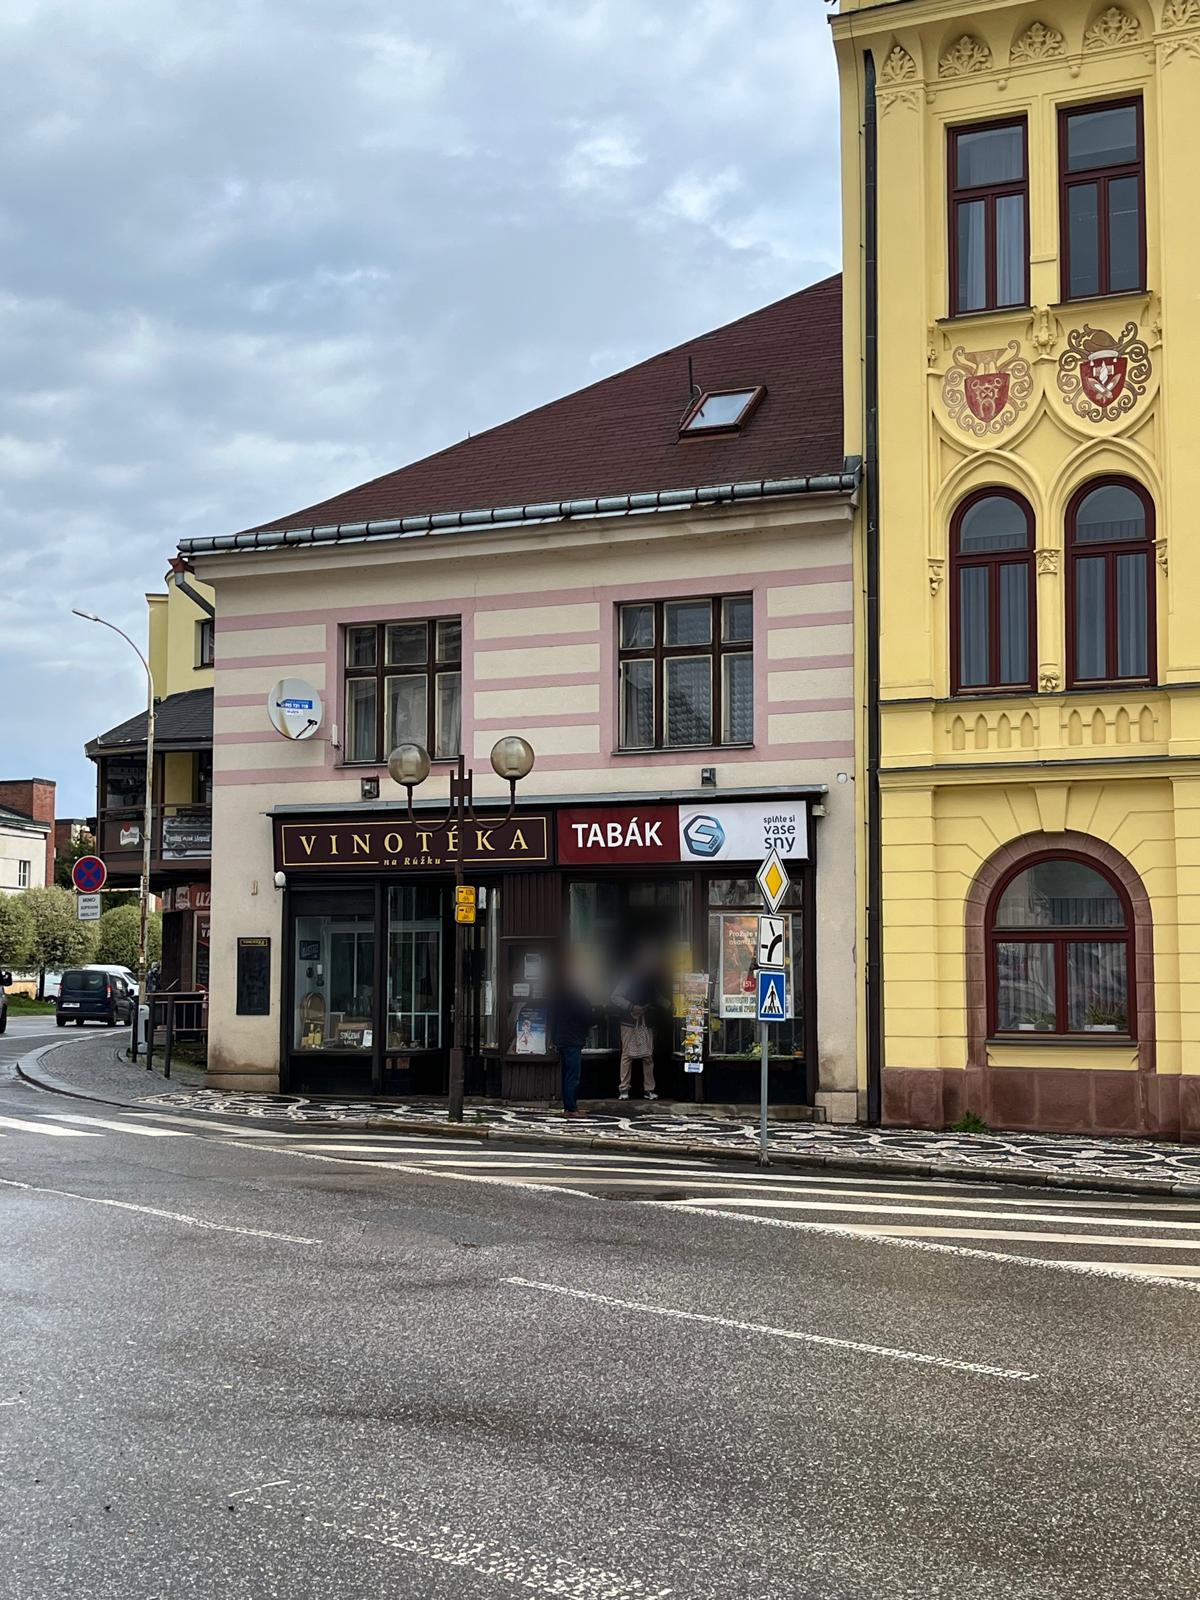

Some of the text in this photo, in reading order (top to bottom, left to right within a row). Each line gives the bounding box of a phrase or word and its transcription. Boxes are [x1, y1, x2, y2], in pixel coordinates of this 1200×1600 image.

[298, 825, 529, 856] VINOTÉKA
[571, 816, 663, 848] TABÁK
[764, 836, 796, 853] sny
